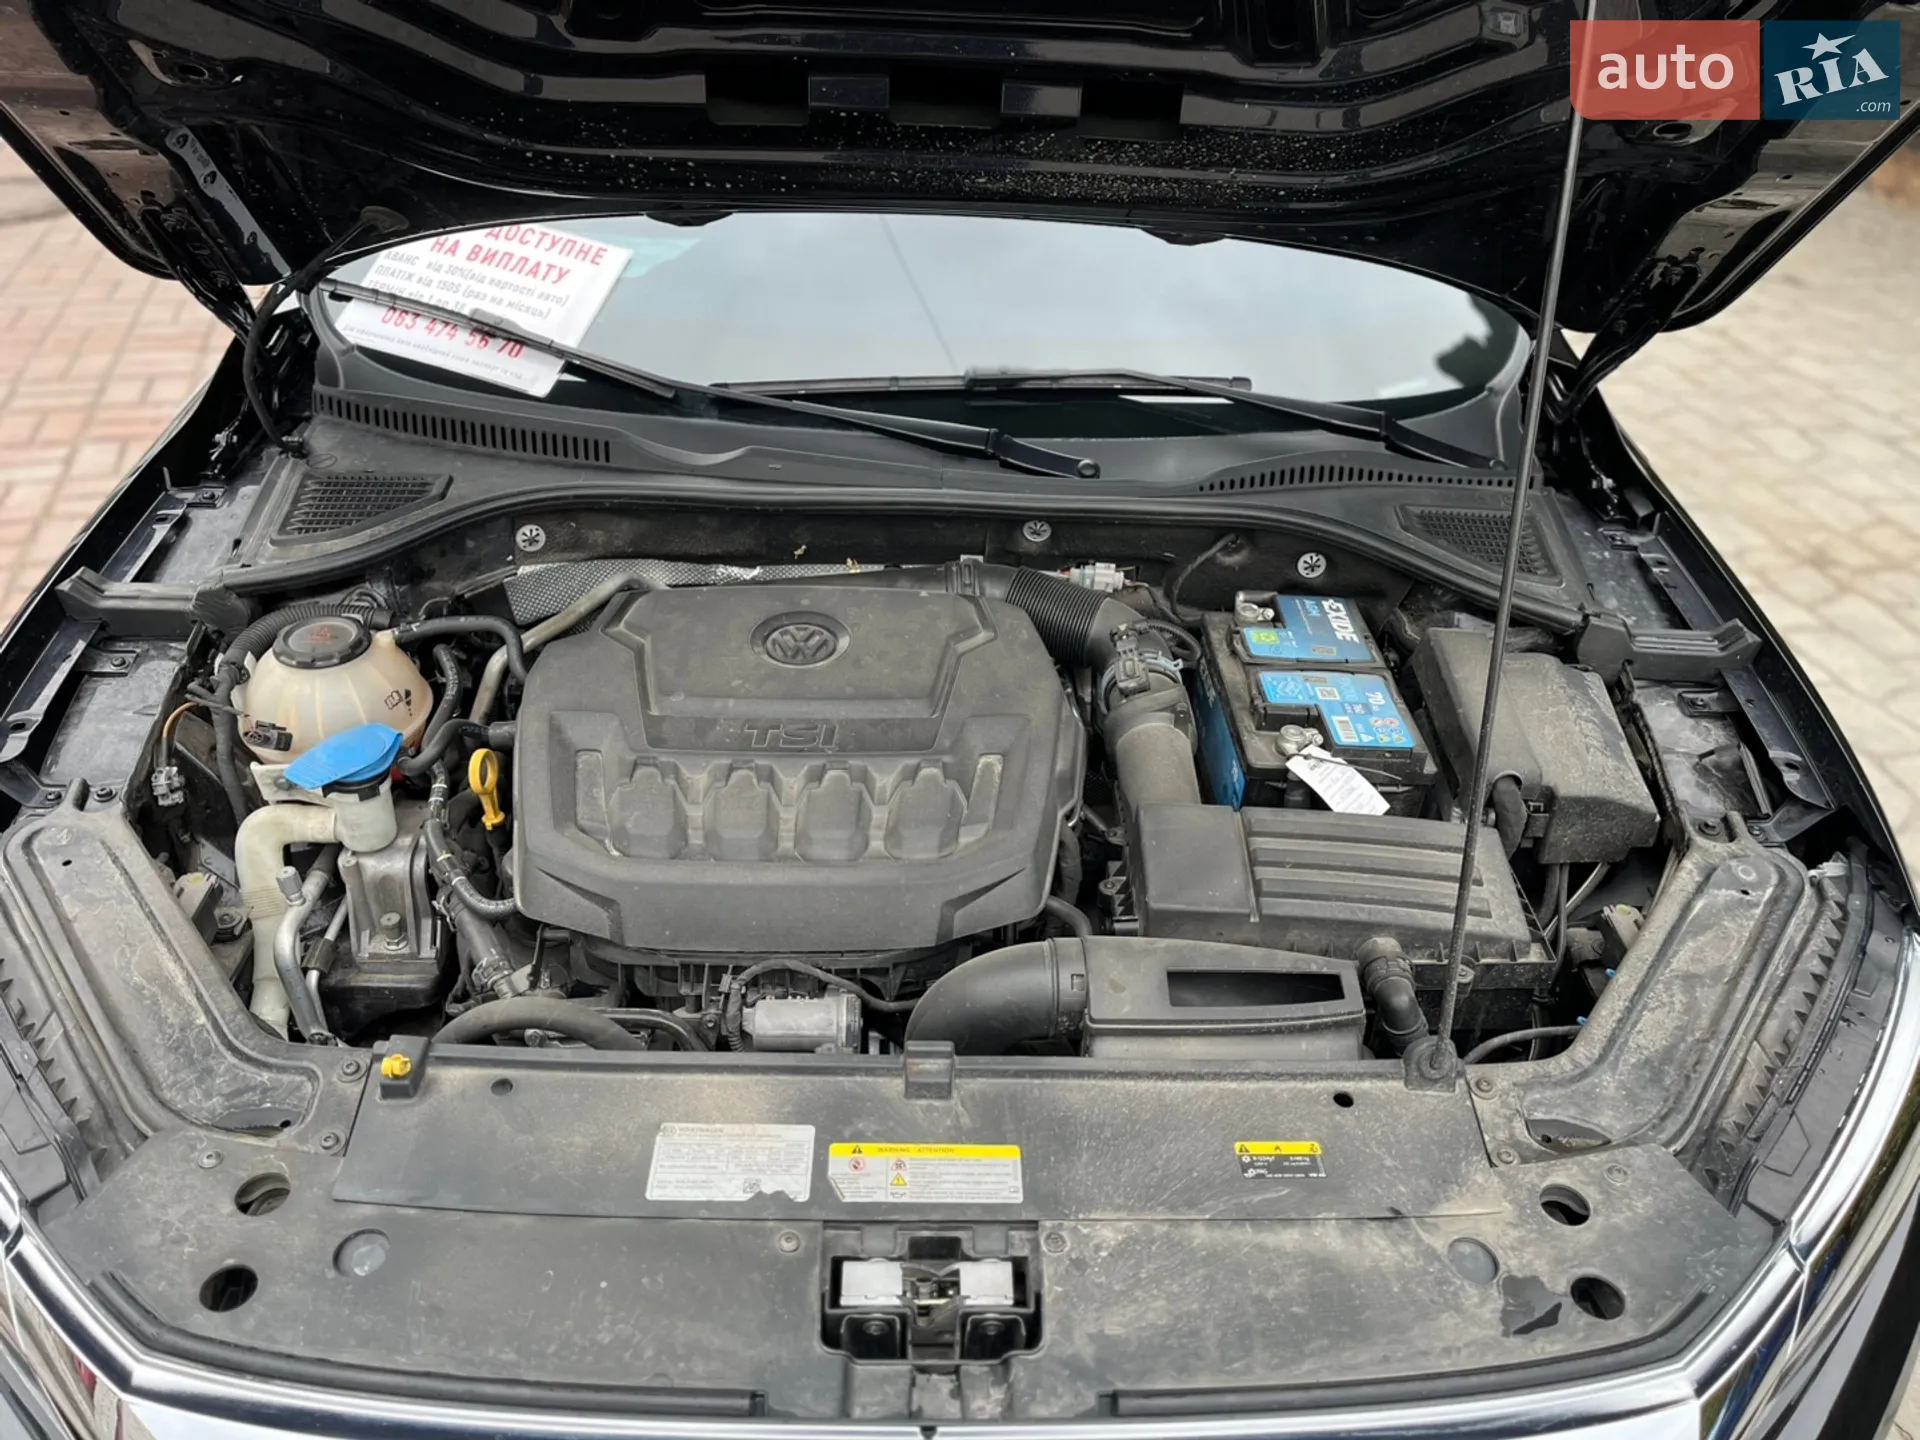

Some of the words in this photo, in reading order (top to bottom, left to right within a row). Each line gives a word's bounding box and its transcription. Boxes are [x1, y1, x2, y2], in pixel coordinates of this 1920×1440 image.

[384, 250, 419, 266] АВАНС
[430, 236, 460, 257] НА
[465, 243, 571, 285] ВИПЛАТУ
[484, 223, 608, 266] ДОСТУПНЕ
[374, 264, 416, 281] ПЛАТІЖ
[381, 303, 422, 330] 063
[424, 317, 459, 341] 474
[464, 327, 491, 350] 56
[497, 337, 524, 358] 70
[1321, 598, 1360, 644] EXIDE
[1365, 691, 1386, 705] 70
[744, 718, 839, 749] TSI
